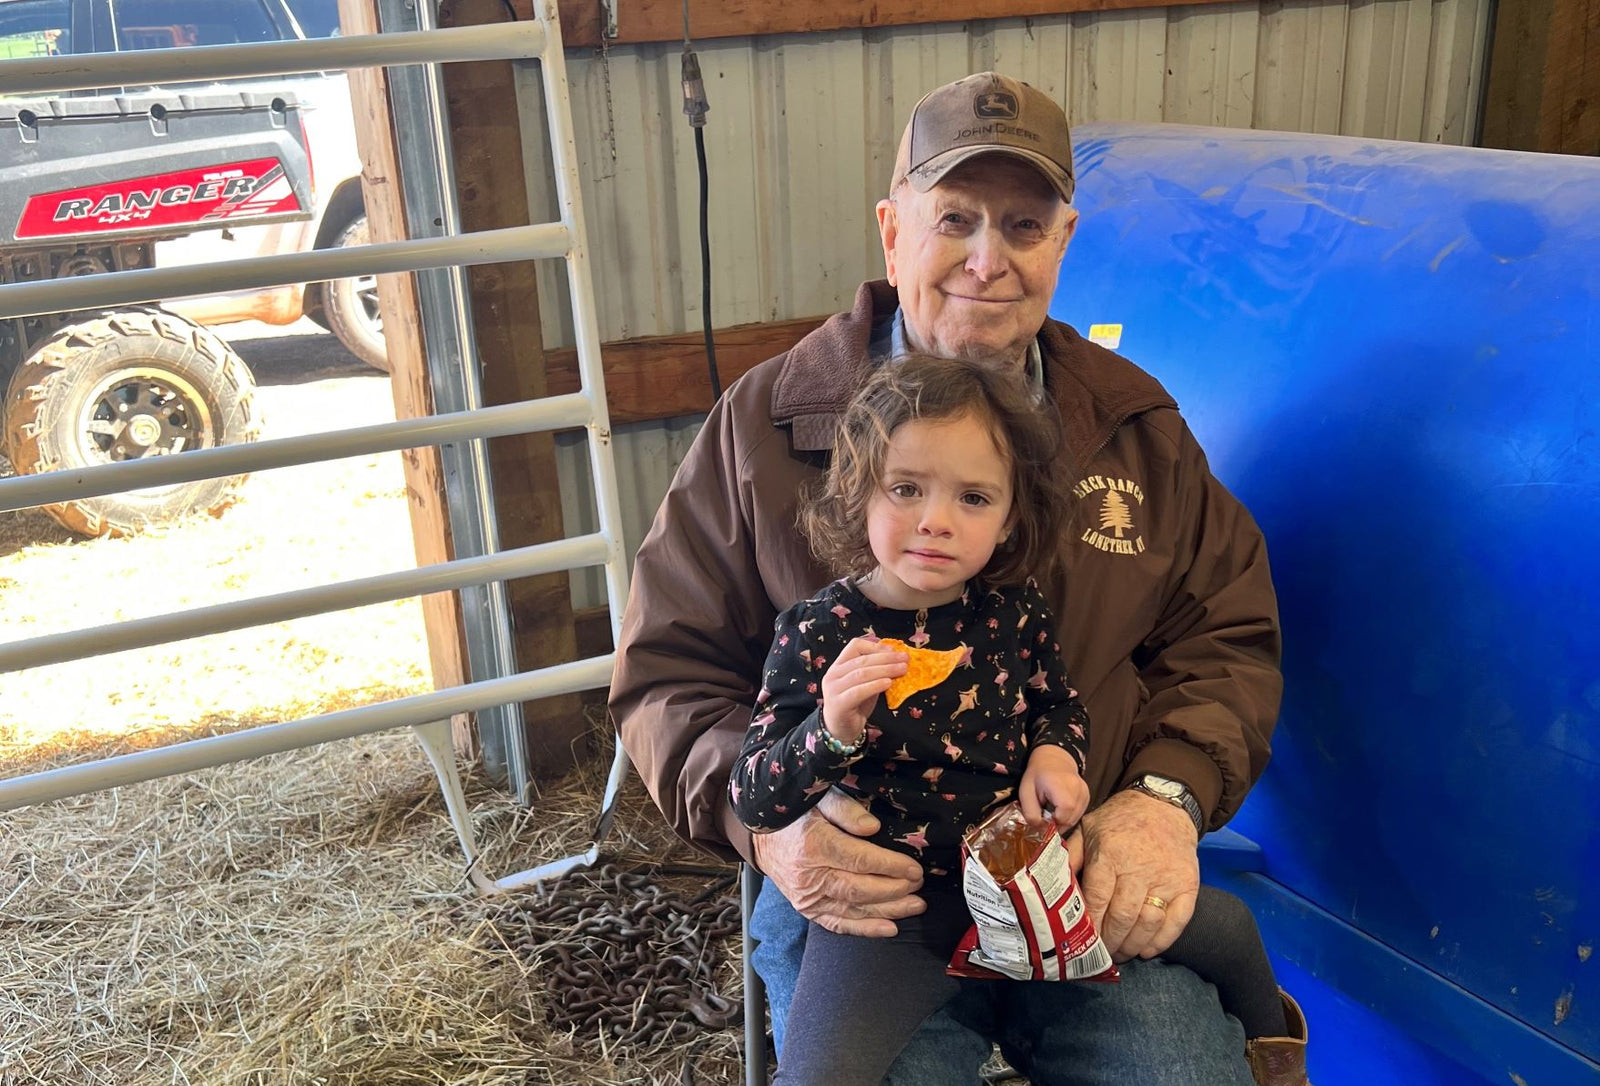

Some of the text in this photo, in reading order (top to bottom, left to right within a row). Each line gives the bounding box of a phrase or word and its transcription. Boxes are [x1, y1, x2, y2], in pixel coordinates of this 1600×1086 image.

[953, 123, 1041, 143] JOHN DEERE
[53, 176, 257, 222] RANGER
[966, 888, 996, 906] Nutrition
